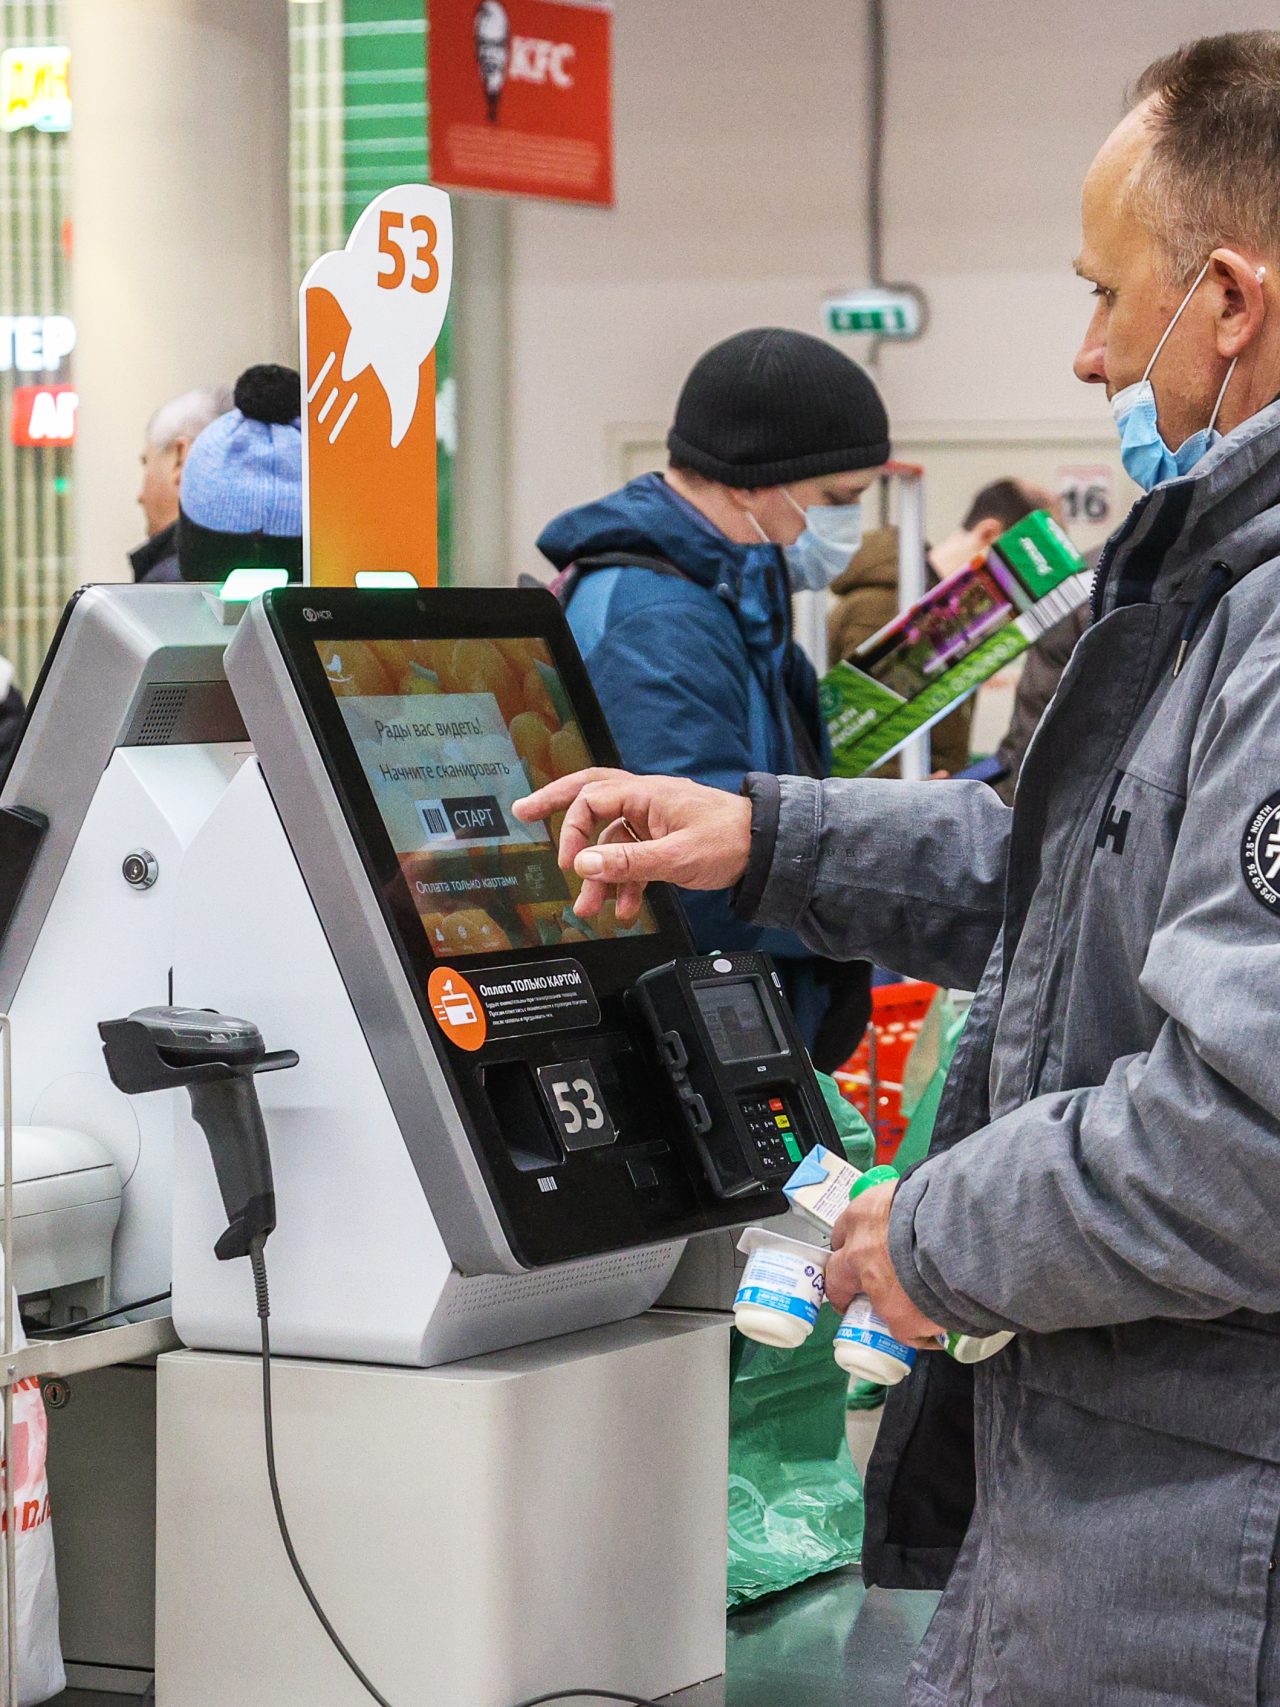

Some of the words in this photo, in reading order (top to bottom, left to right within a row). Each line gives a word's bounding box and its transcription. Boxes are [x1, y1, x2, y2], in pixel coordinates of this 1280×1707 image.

[509, 35, 576, 89] KFC
[377, 210, 439, 294] 53
[1062, 485, 1110, 520] 16
[375, 720, 411, 741] Рады
[413, 724, 434, 737] вас
[436, 717, 484, 738] видеть!
[379, 764, 437, 781] Начните
[438, 762, 510, 780] сканировать
[454, 809, 494, 828] СТАРТ
[1250, 805, 1273, 833] NORTH
[416, 880, 449, 894] Оплата
[451, 879, 481, 892] только
[482, 876, 518, 891] картами
[1260, 887, 1277, 904] GPS
[480, 984, 513, 997] Оплата
[511, 977, 547, 993] ТОЛЬКО
[547, 969, 582, 988] КАРТОЙ
[552, 1078, 604, 1134] 53
